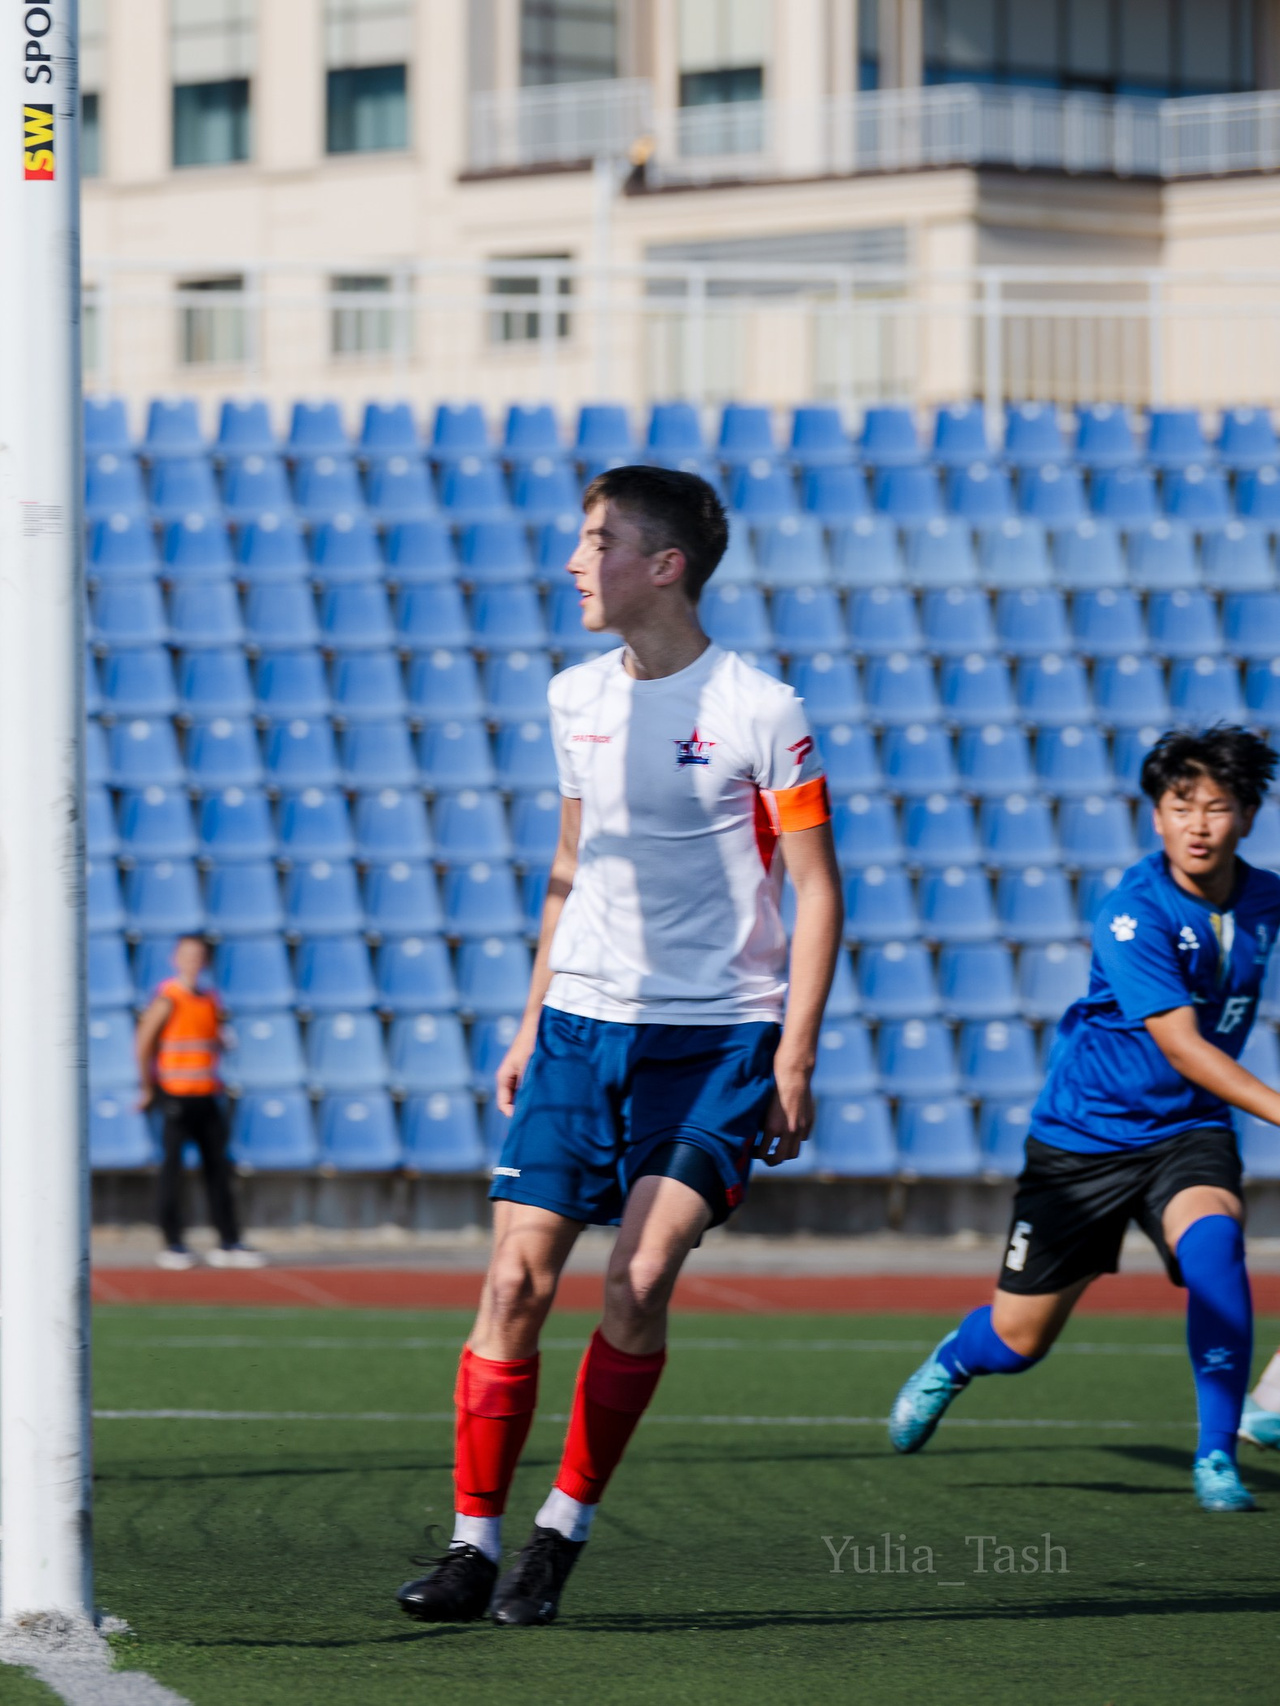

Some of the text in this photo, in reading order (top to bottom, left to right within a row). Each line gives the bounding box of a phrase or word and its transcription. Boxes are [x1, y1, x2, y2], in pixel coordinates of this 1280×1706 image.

[24, 0, 54, 172] SW SPO
[1005, 1220, 1034, 1272] 5
